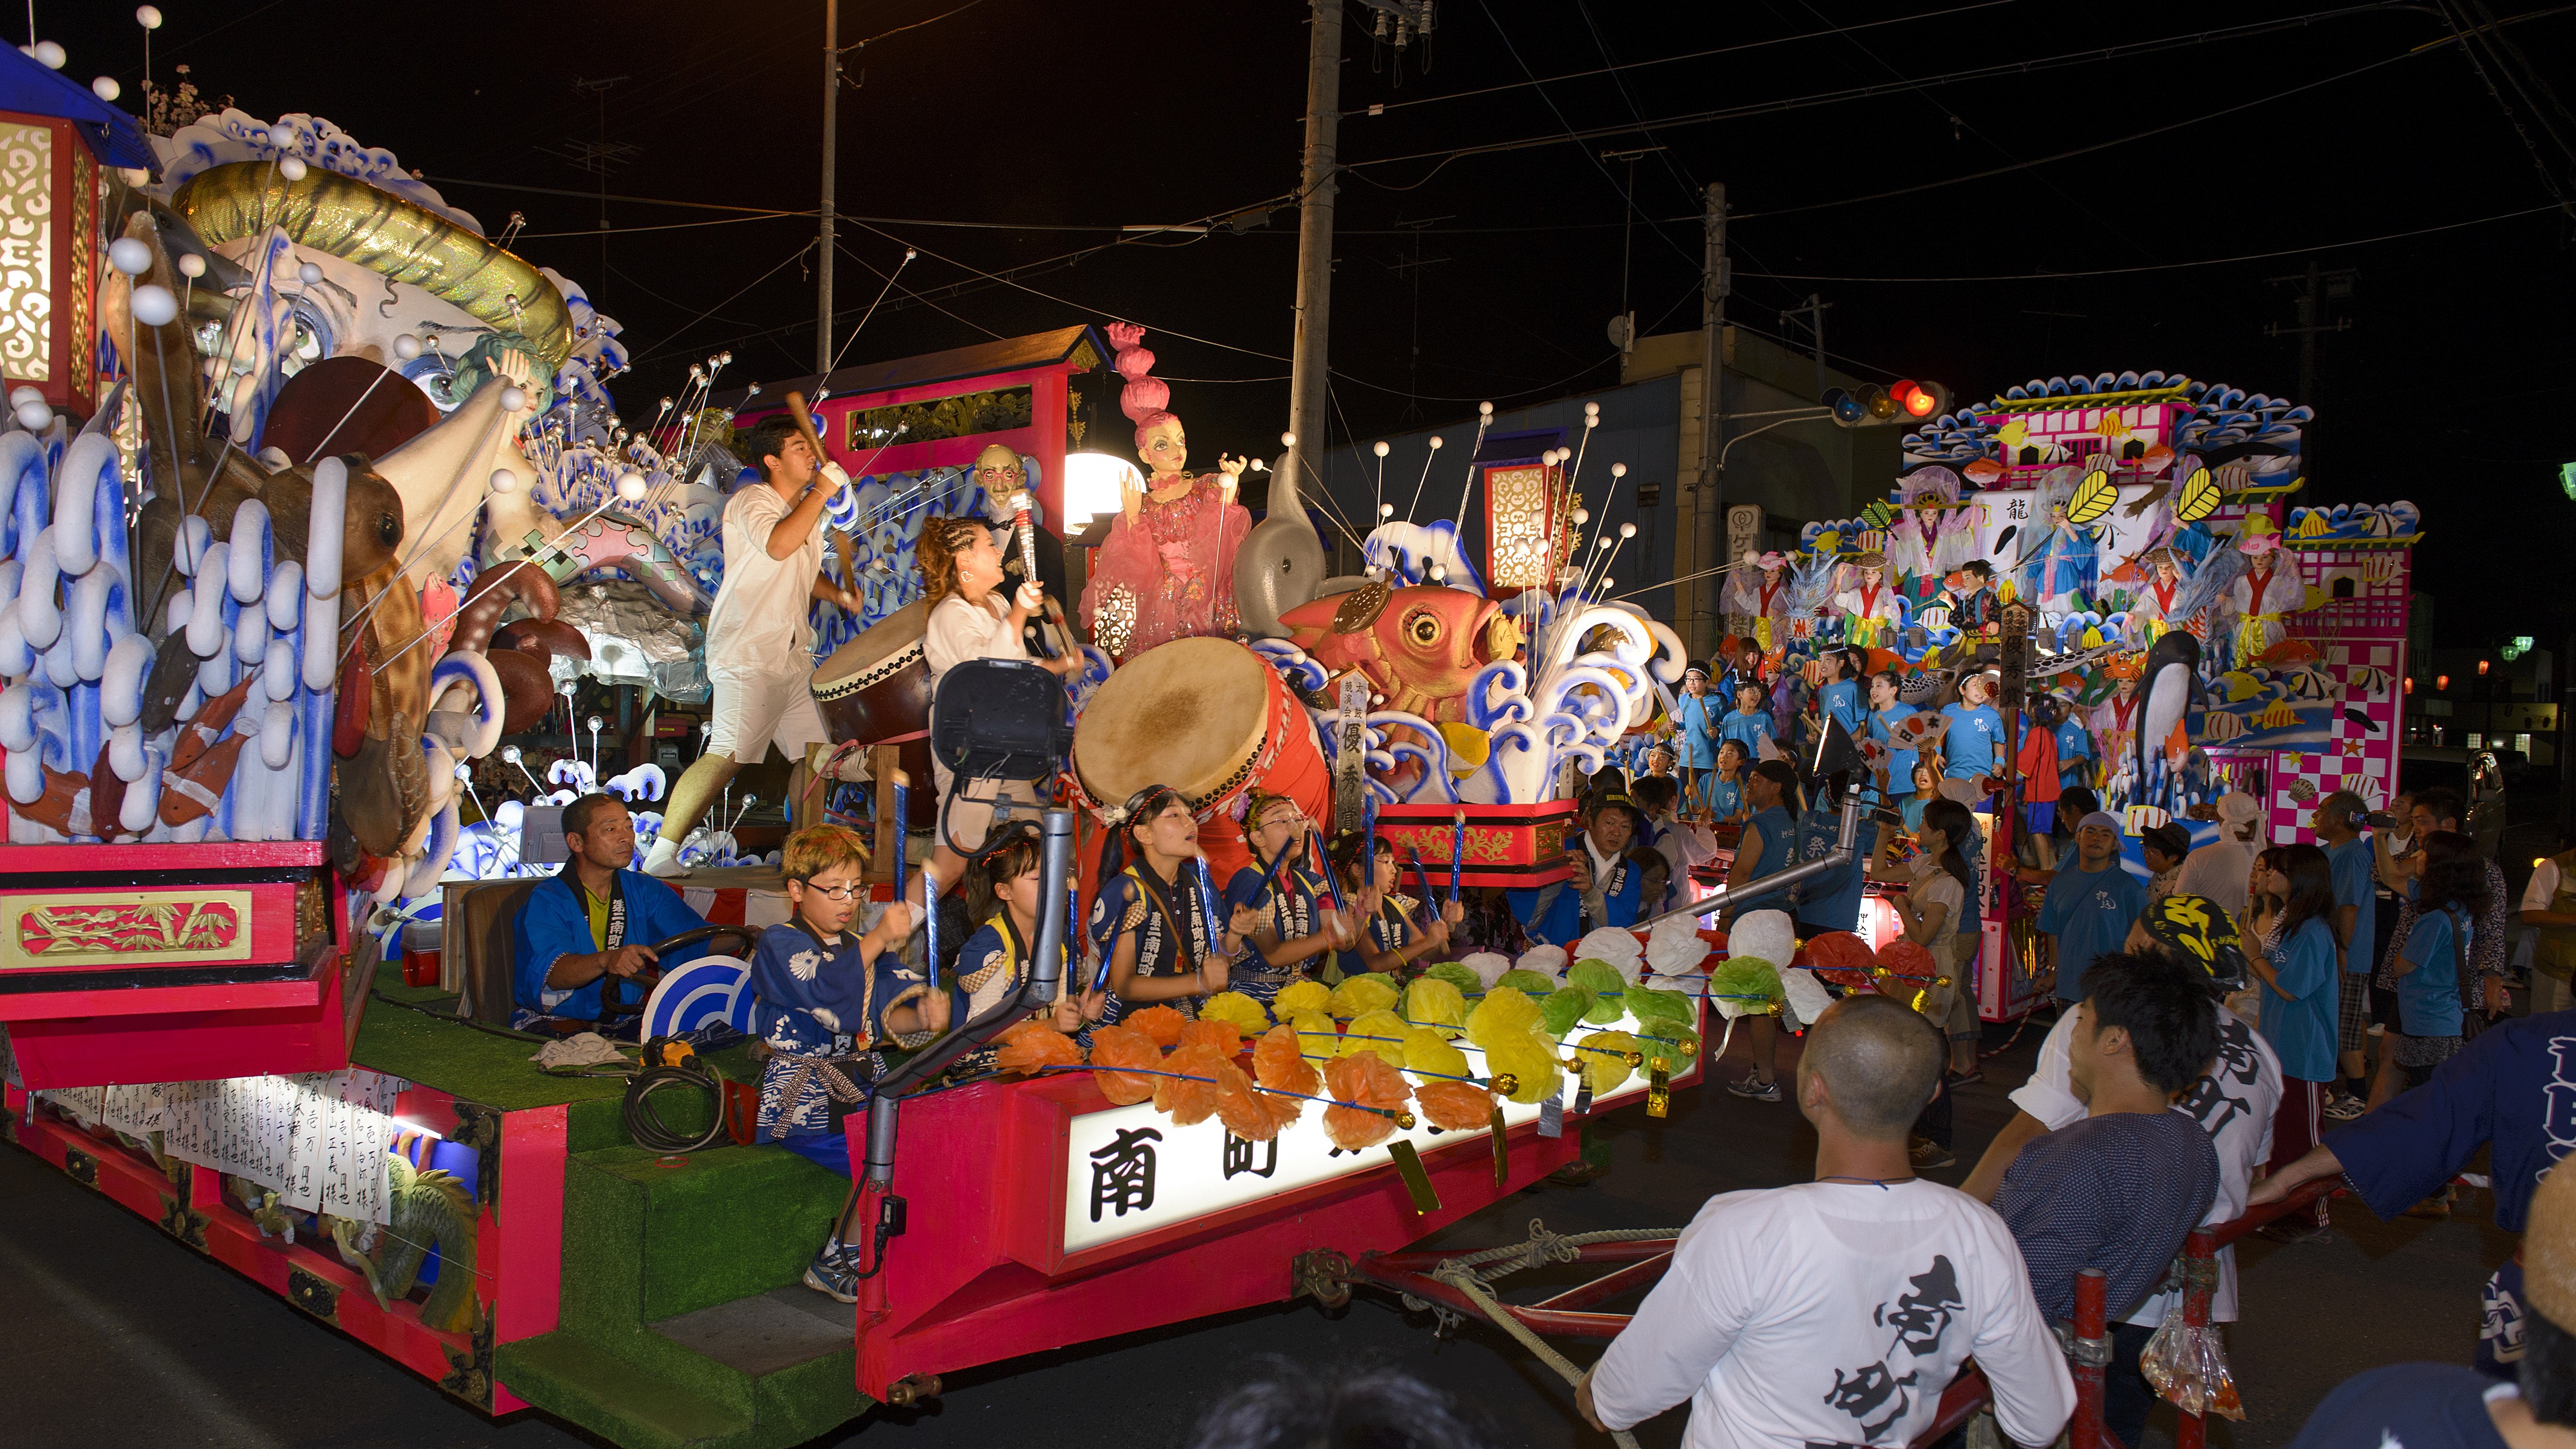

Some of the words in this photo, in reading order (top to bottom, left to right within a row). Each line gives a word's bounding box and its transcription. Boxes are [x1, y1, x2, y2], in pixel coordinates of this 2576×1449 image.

[2006, 498, 2028, 520] 龍
[2004, 636, 2024, 705] 優秀賞
[1341, 722, 1361, 833] 優秀賞
